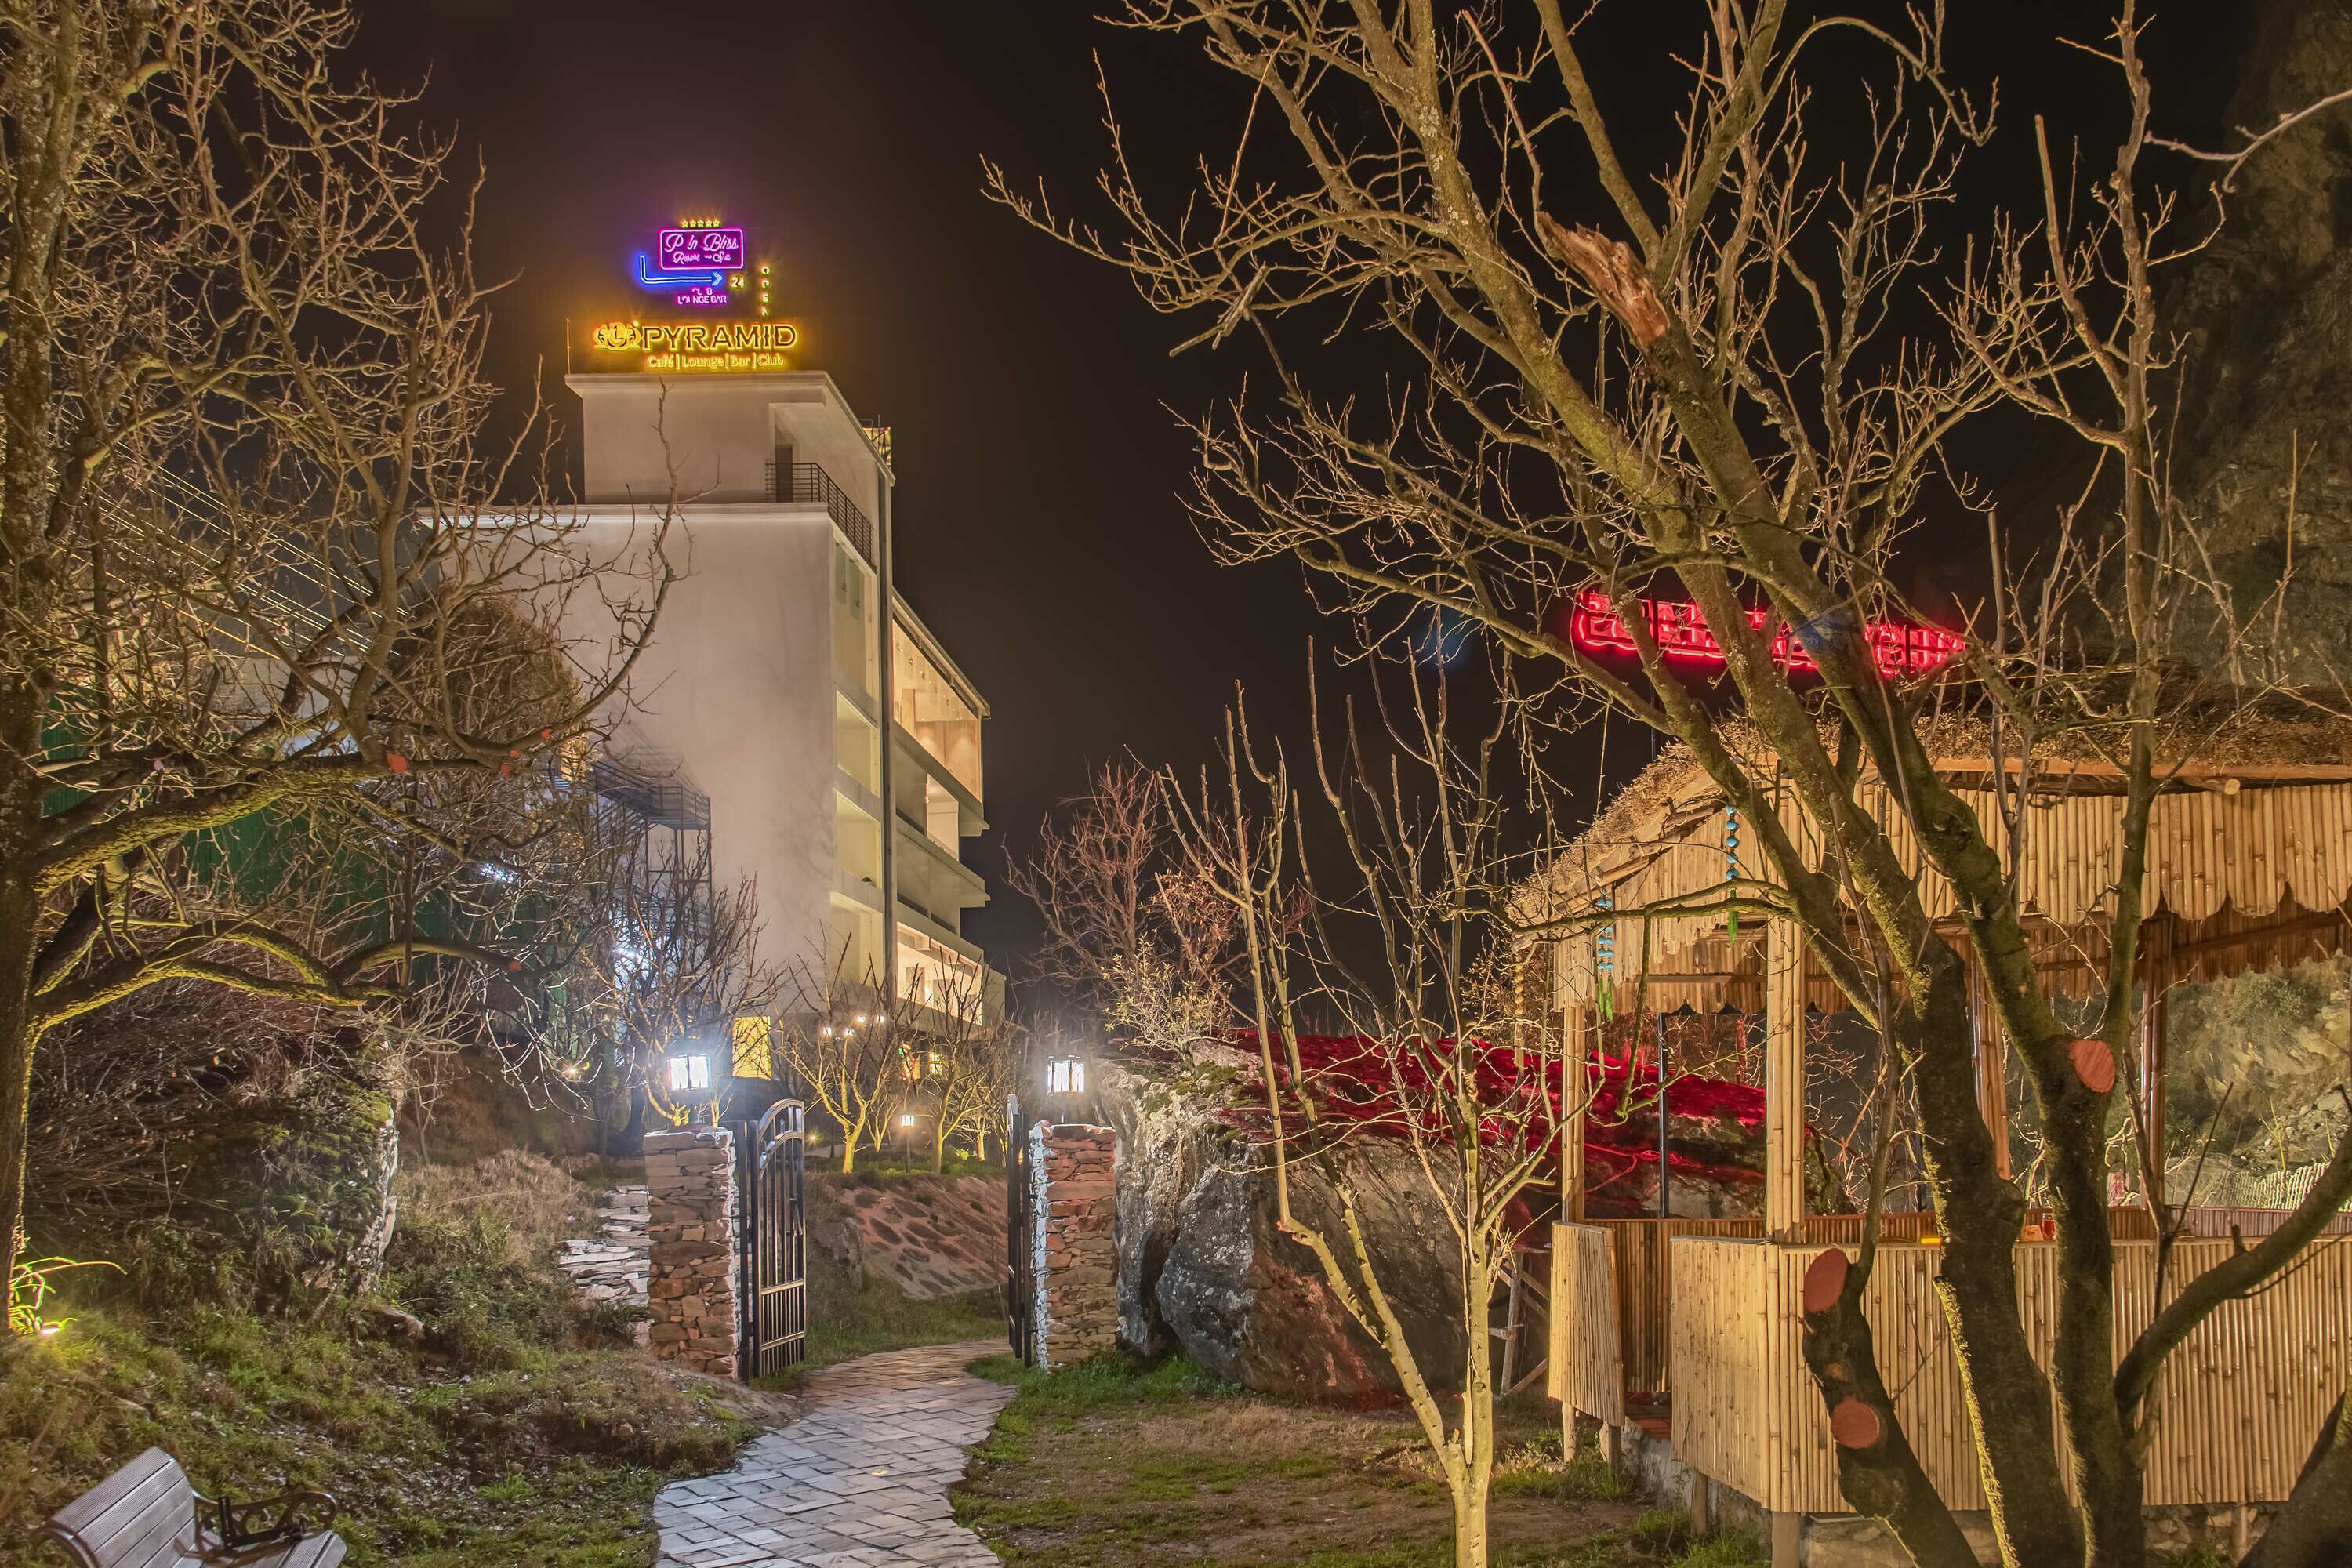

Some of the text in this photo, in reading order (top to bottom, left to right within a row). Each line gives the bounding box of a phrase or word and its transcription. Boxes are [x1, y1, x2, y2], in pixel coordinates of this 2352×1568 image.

[664, 233, 684, 252] P
[731, 277, 744, 289] 24
[641, 324, 797, 351] PYRAMID
[681, 355, 724, 369] Lounge
[730, 355, 751, 366] Bar
[757, 353, 785, 366] Club
